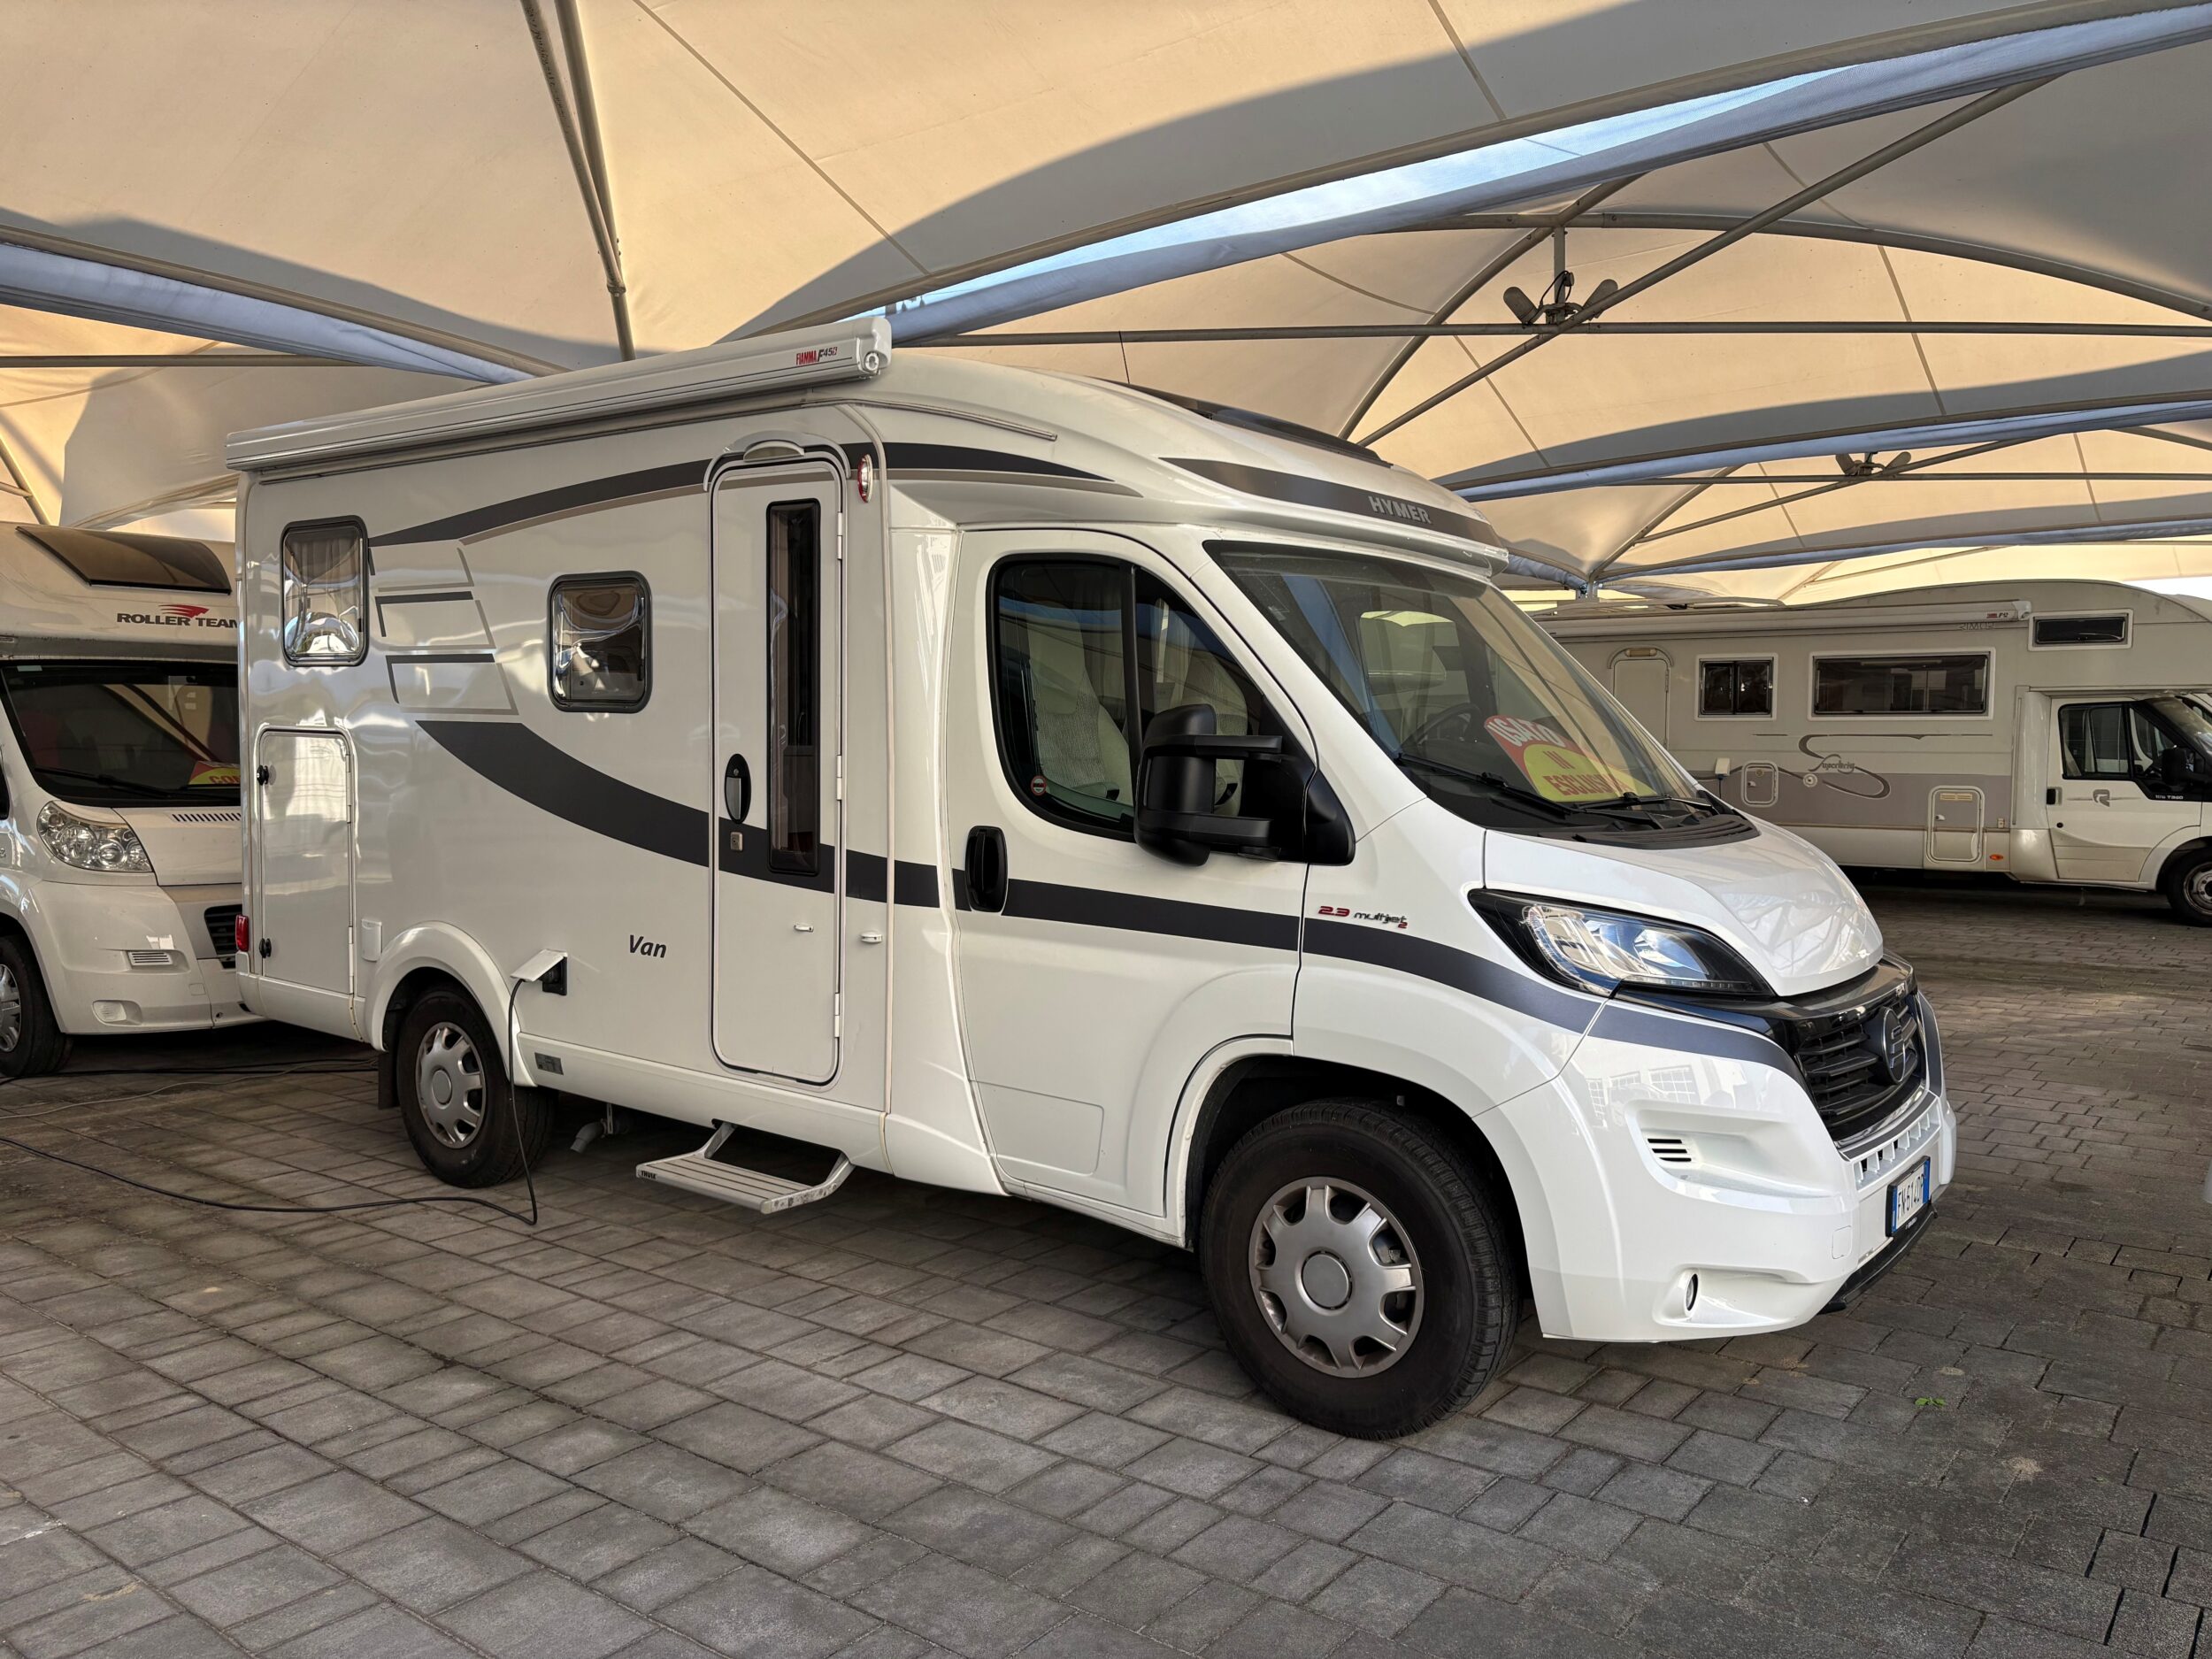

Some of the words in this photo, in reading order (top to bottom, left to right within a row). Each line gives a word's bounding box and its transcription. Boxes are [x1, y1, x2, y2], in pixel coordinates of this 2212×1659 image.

[796, 350, 818, 365] FIAMMA
[1368, 495, 1432, 524] HYMER
[117, 613, 190, 626] ROLLER
[1486, 718, 1566, 748] USATO
[1354, 912, 1407, 924] multijet
[629, 934, 667, 958] Van
[641, 1170, 657, 1179] THULE
